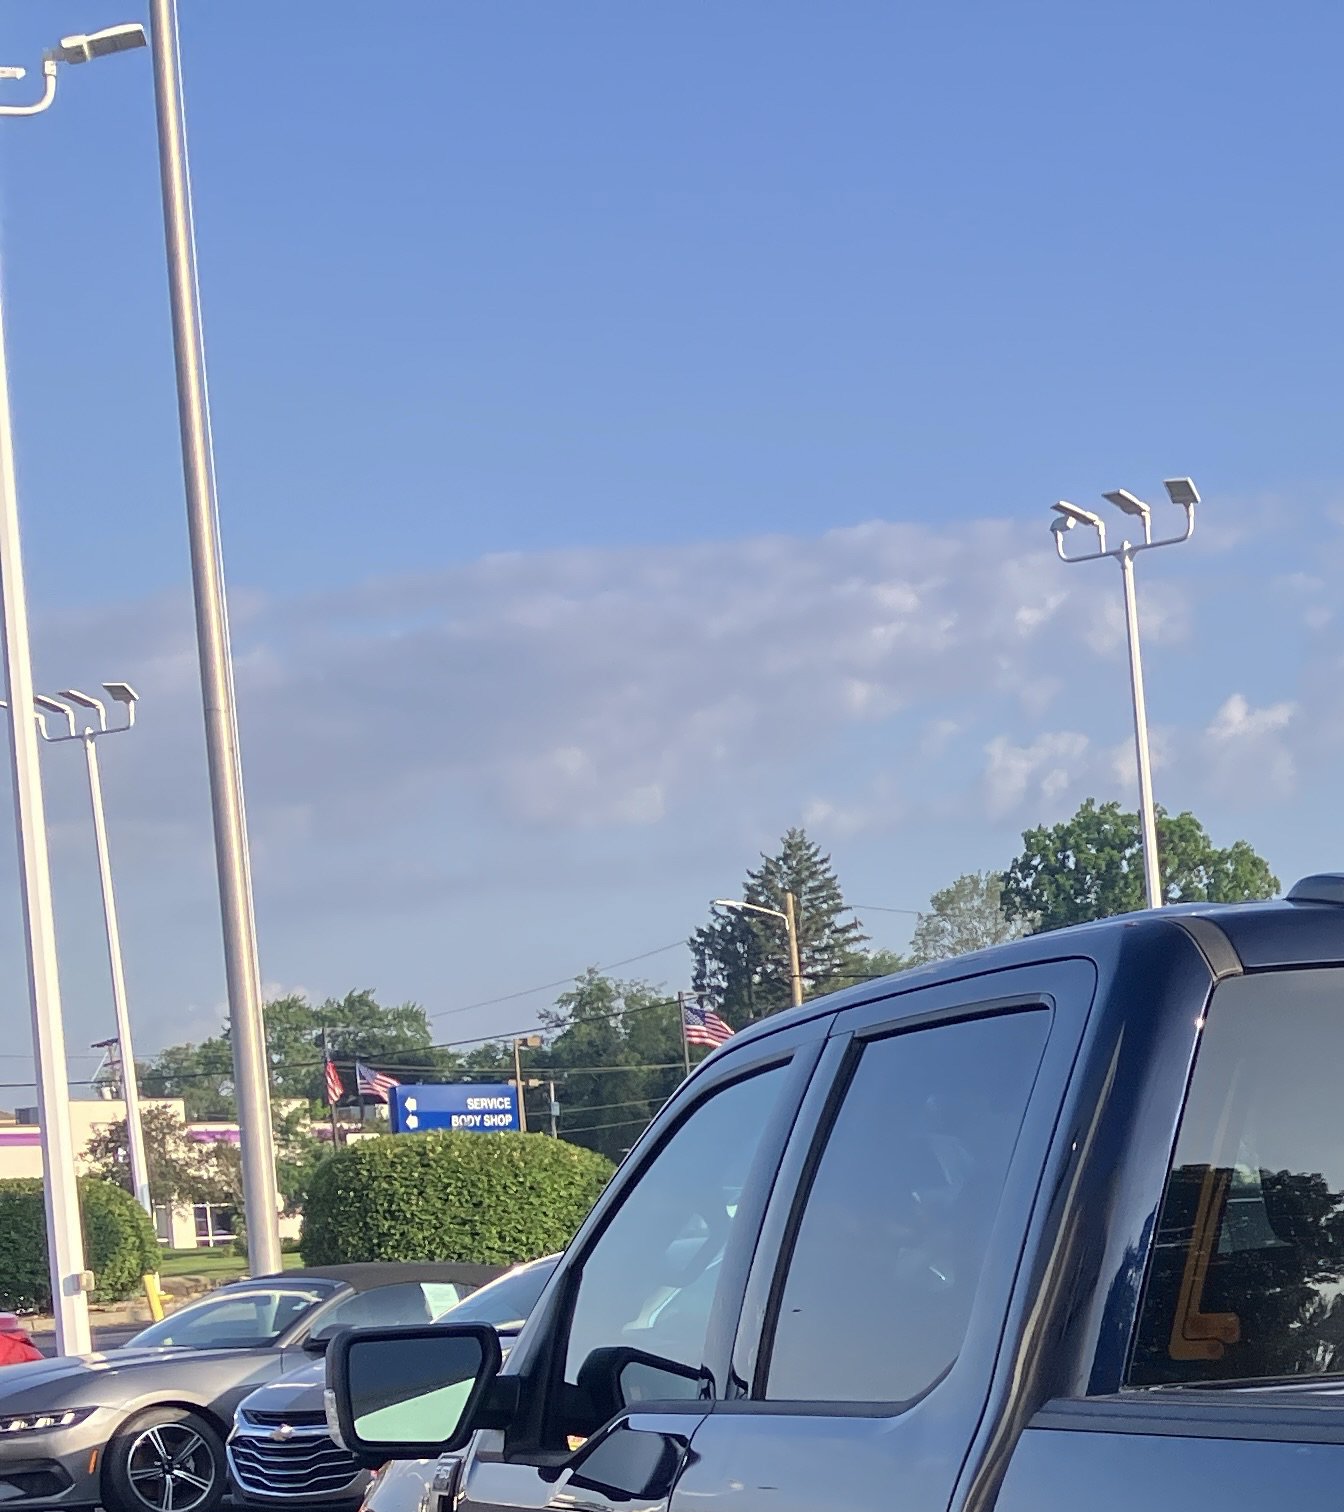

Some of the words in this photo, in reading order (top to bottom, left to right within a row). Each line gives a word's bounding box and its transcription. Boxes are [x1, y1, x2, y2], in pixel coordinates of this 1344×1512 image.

[466, 1097, 512, 1110] SERVICE
[451, 1114, 481, 1127] BODY
[483, 1114, 513, 1127] SHOP
